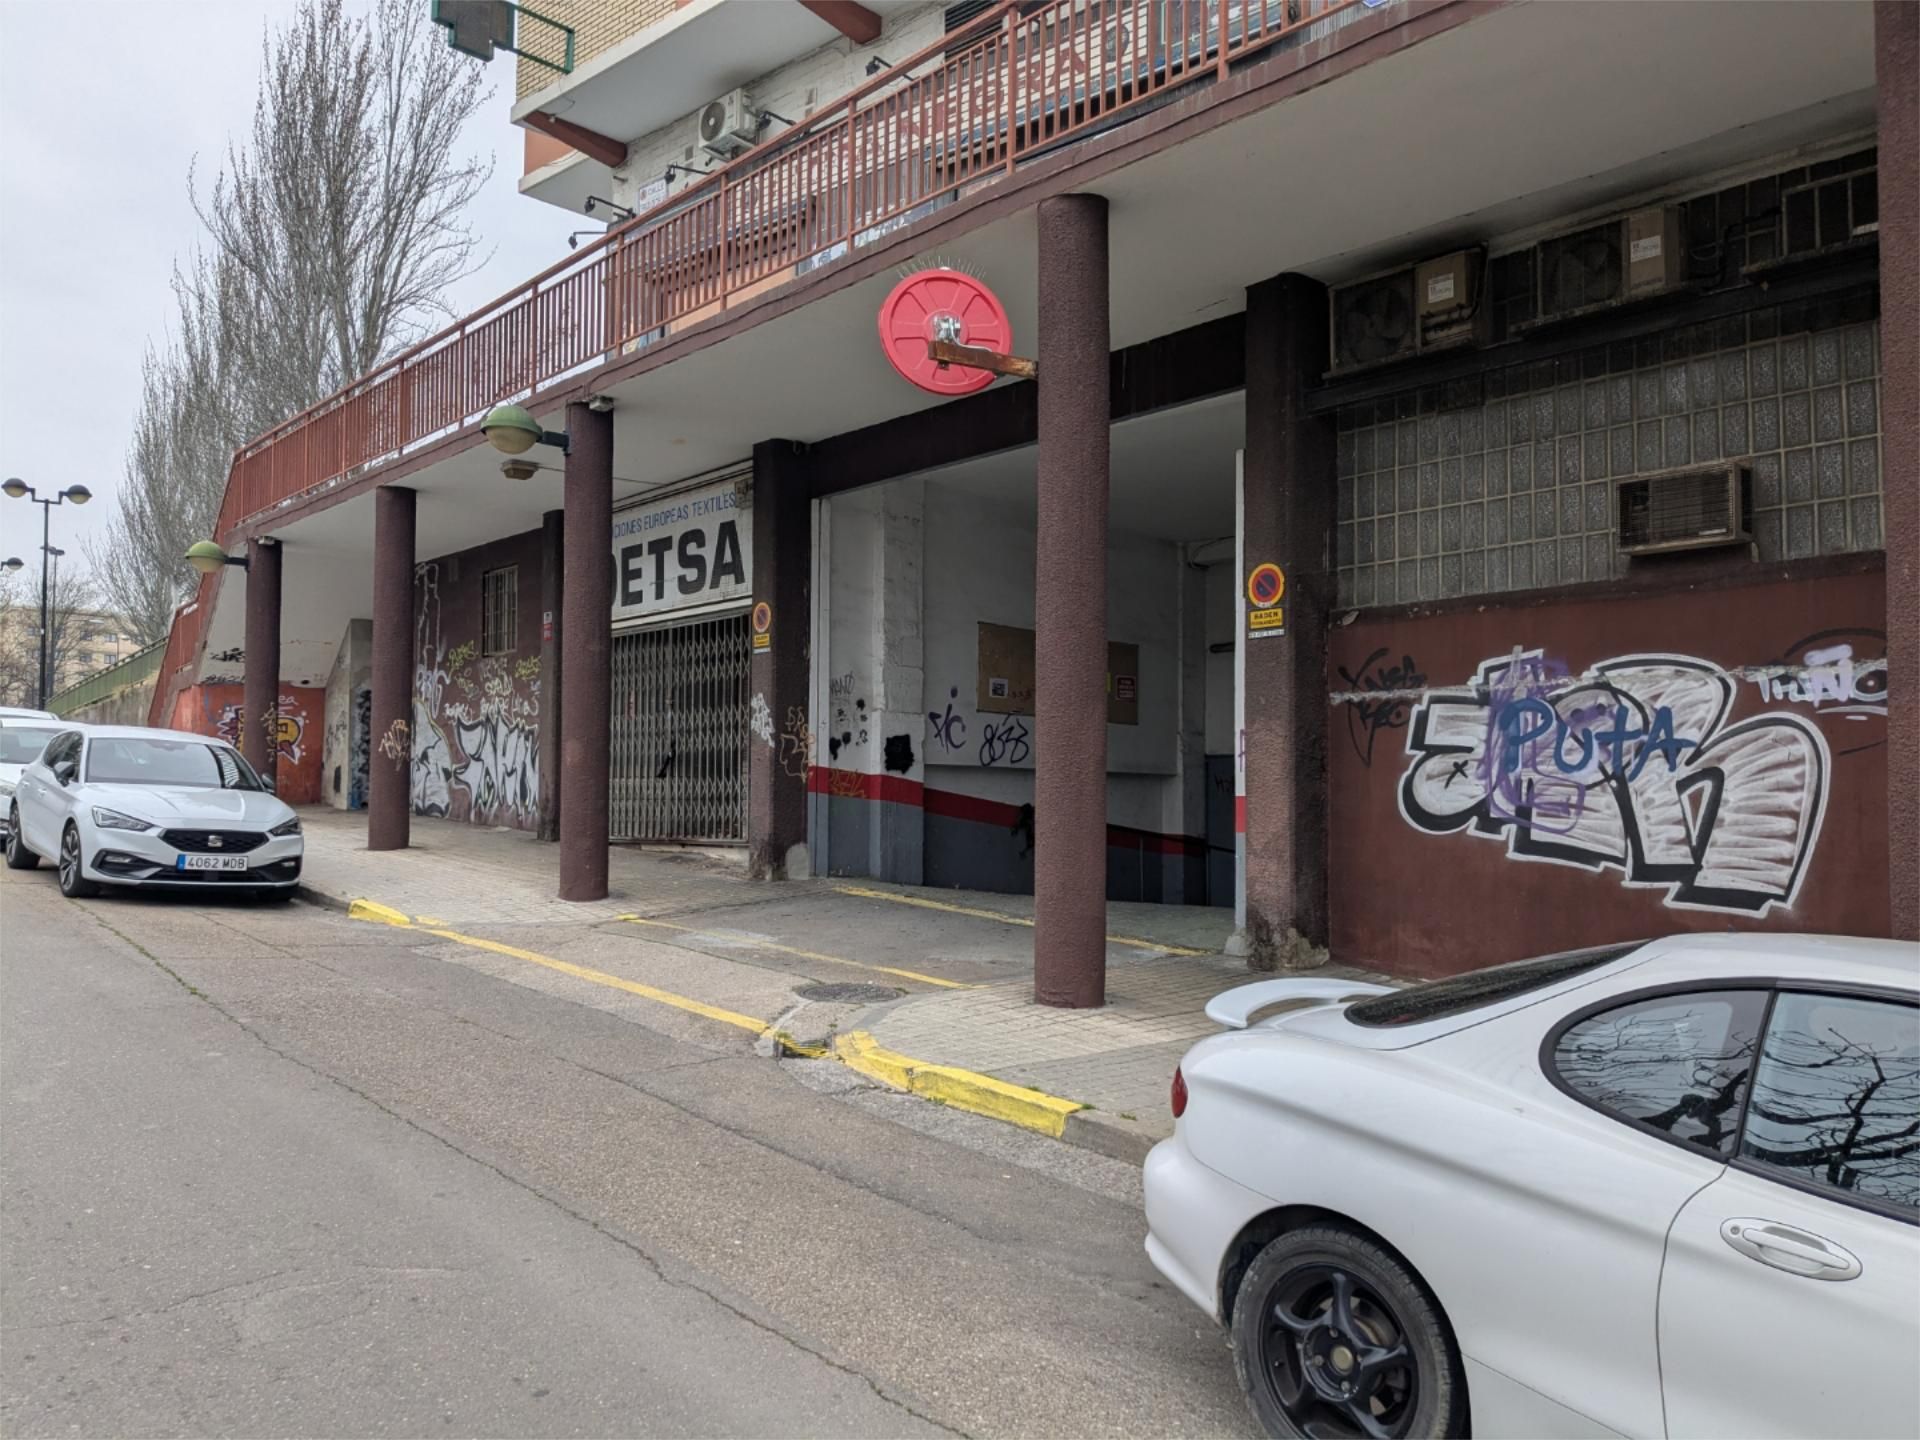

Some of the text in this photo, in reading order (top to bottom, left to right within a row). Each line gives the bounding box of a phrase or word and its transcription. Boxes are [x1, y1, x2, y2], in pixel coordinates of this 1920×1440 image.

[644, 504, 689, 530] EUROPEAS
[692, 492, 737, 517] TEXTILES
[187, 857, 219, 869] 4062
